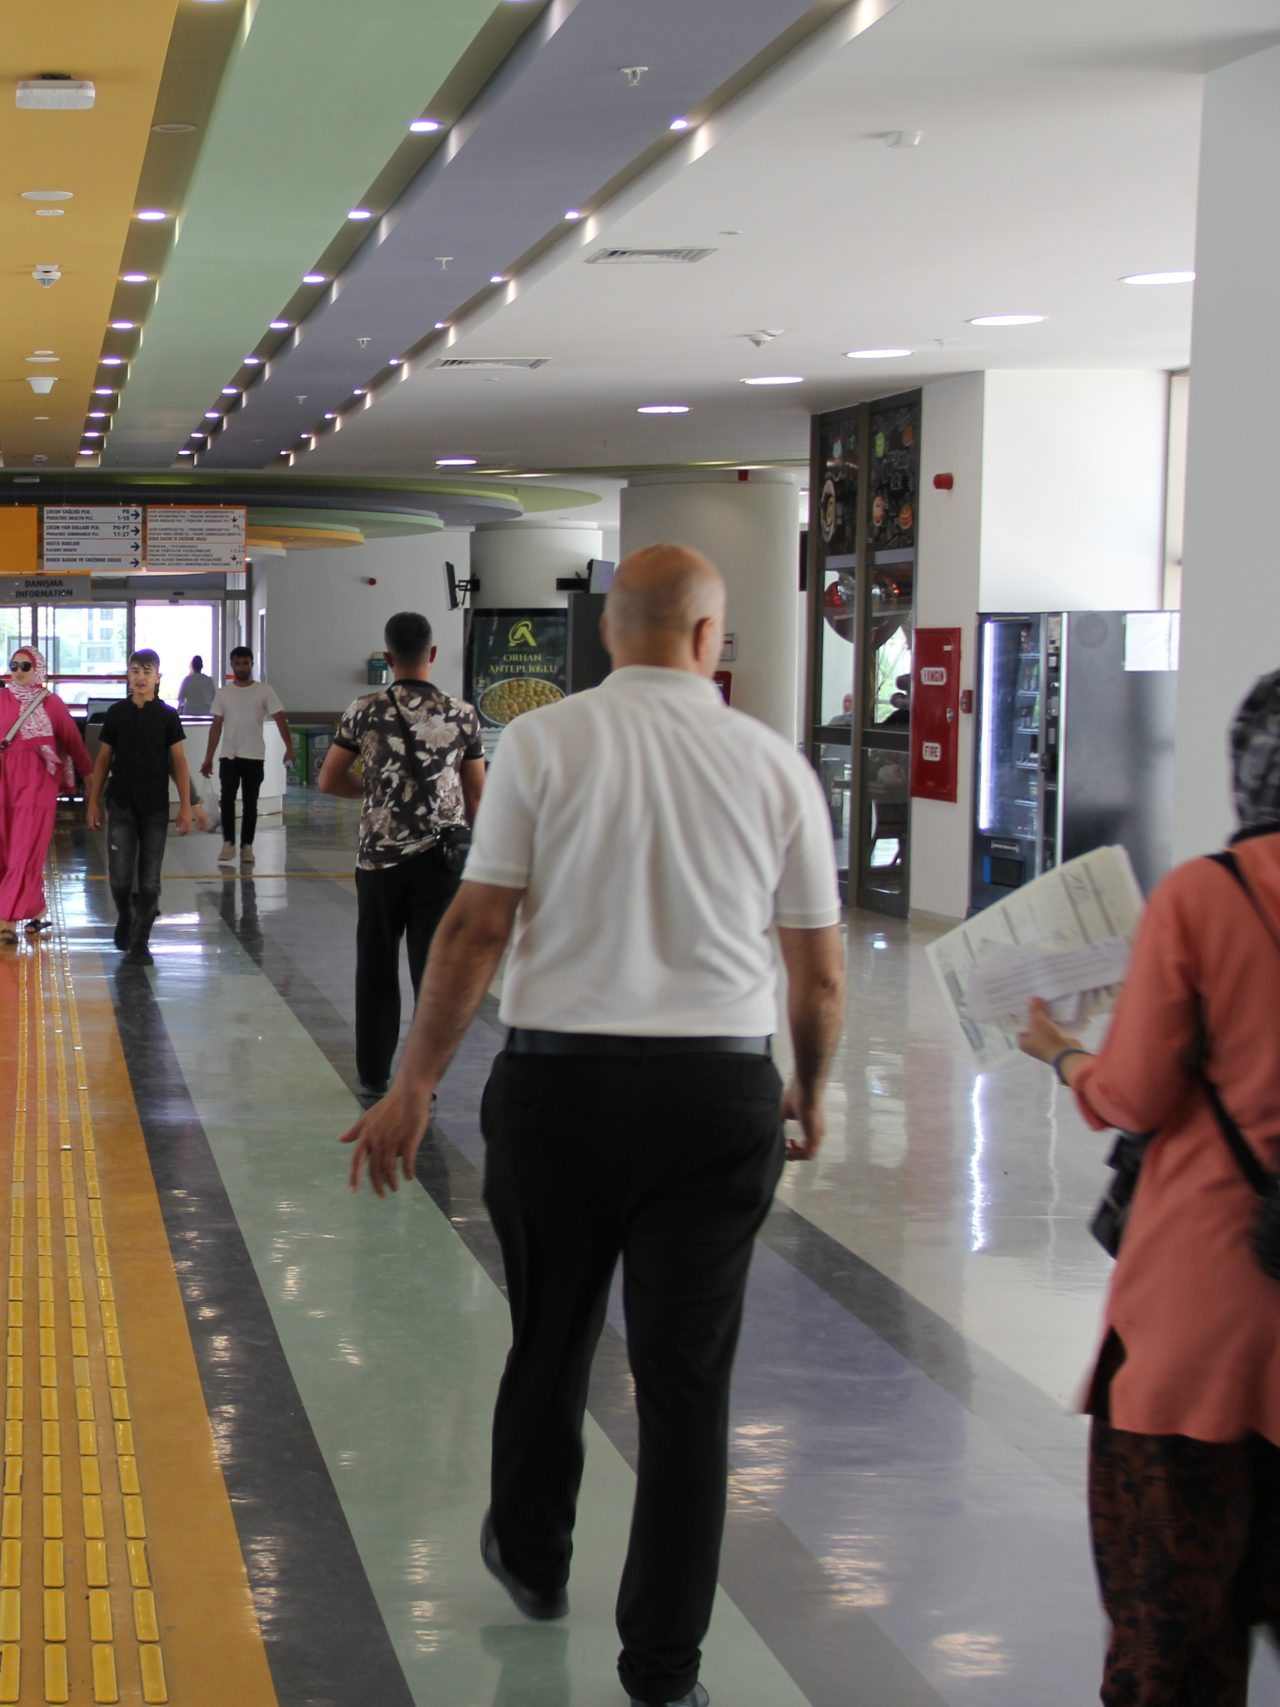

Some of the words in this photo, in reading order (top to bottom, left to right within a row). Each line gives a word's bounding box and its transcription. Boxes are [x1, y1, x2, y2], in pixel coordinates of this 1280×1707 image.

[25, 579, 64, 589] DANIŞMA
[15, 589, 73, 598] INFORMATION
[503, 653, 542, 662] ORHAN
